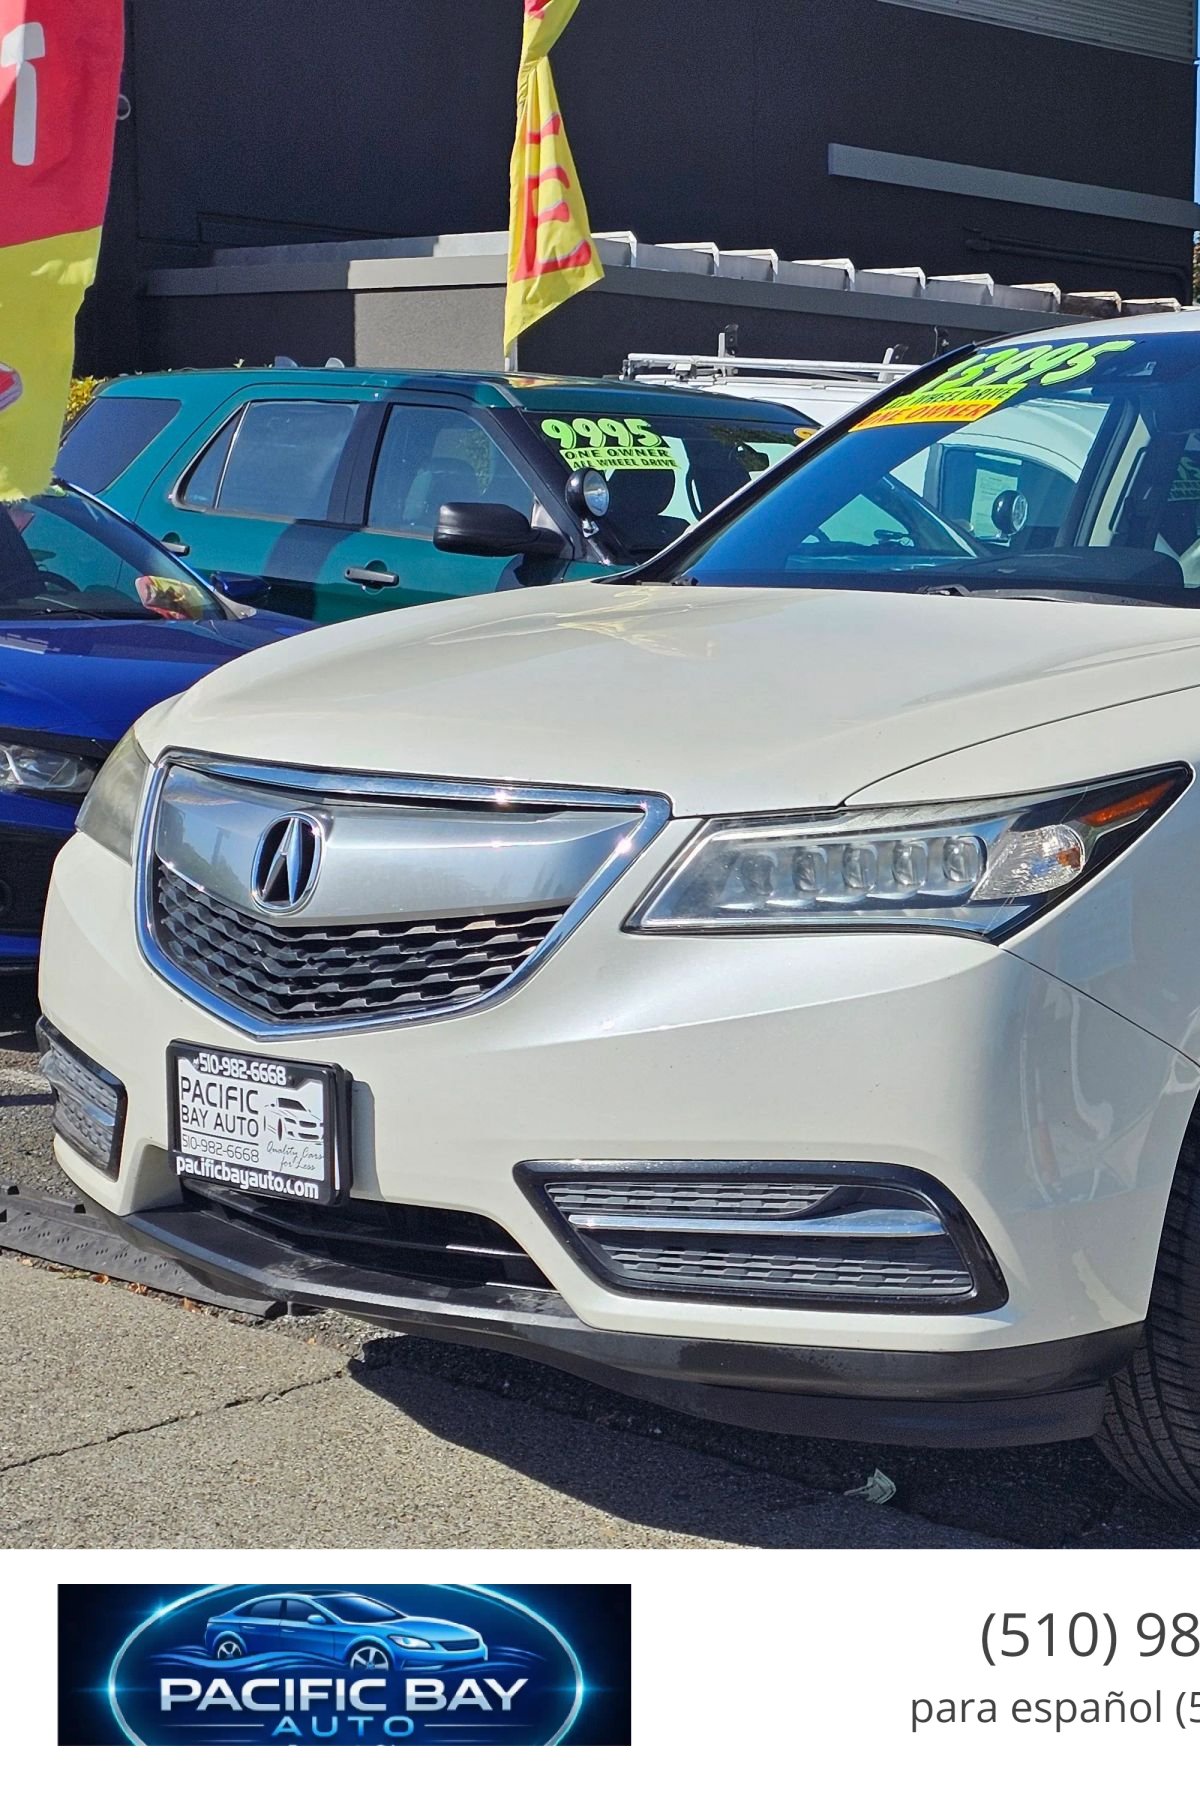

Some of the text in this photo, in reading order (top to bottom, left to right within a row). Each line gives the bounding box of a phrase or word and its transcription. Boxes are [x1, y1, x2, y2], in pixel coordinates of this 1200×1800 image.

[908, 390, 965, 407] WHEEL
[963, 387, 1019, 401] DRIVE
[905, 404, 994, 419] OWNER
[541, 418, 662, 449] 9995
[565, 448, 670, 460] ONE OWNER
[573, 458, 678, 468] ALL WHEEL DRIVE
[199, 1053, 287, 1086] 510-982-6668
[181, 1076, 259, 1115] PACIFIC
[182, 1104, 260, 1138] BAY AUTO
[182, 1133, 260, 1163] 510-982-6668
[266, 1140, 324, 1163] Quality Cars
[295, 1157, 316, 1170] Less
[176, 1155, 319, 1199] pacificbayauto.com
